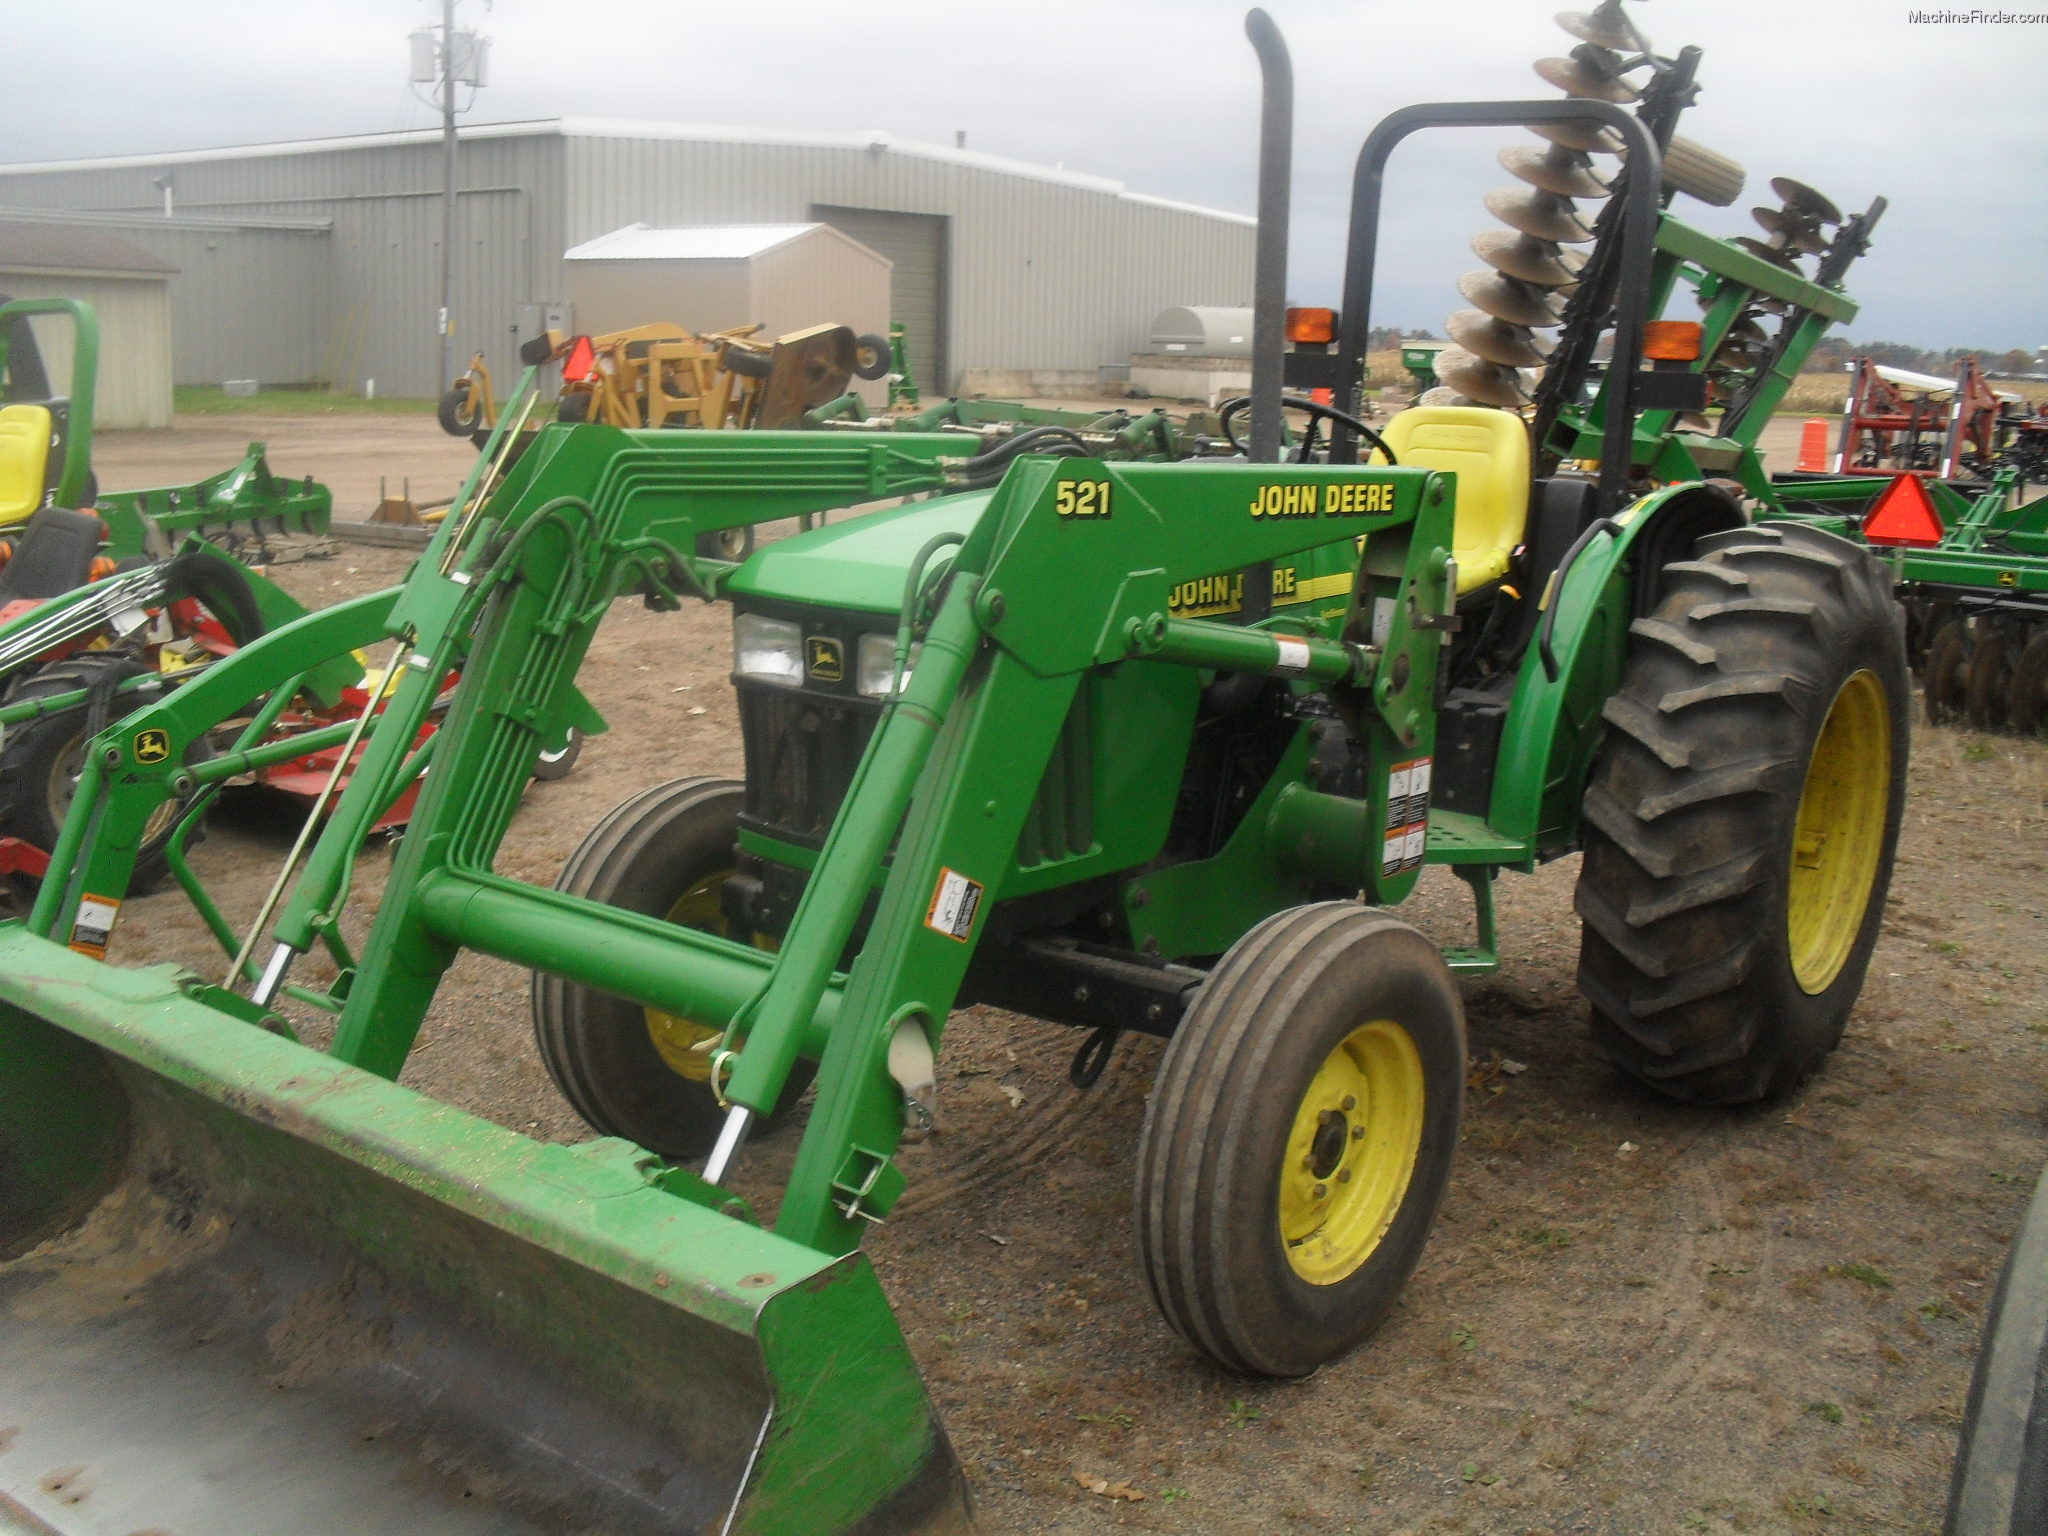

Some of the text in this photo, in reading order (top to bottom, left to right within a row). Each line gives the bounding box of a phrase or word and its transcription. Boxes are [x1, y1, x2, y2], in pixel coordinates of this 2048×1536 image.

[1055, 480, 1110, 516] 521
[1249, 483, 1395, 517] JOHN DEERE
[1168, 574, 1230, 608] JOHN
